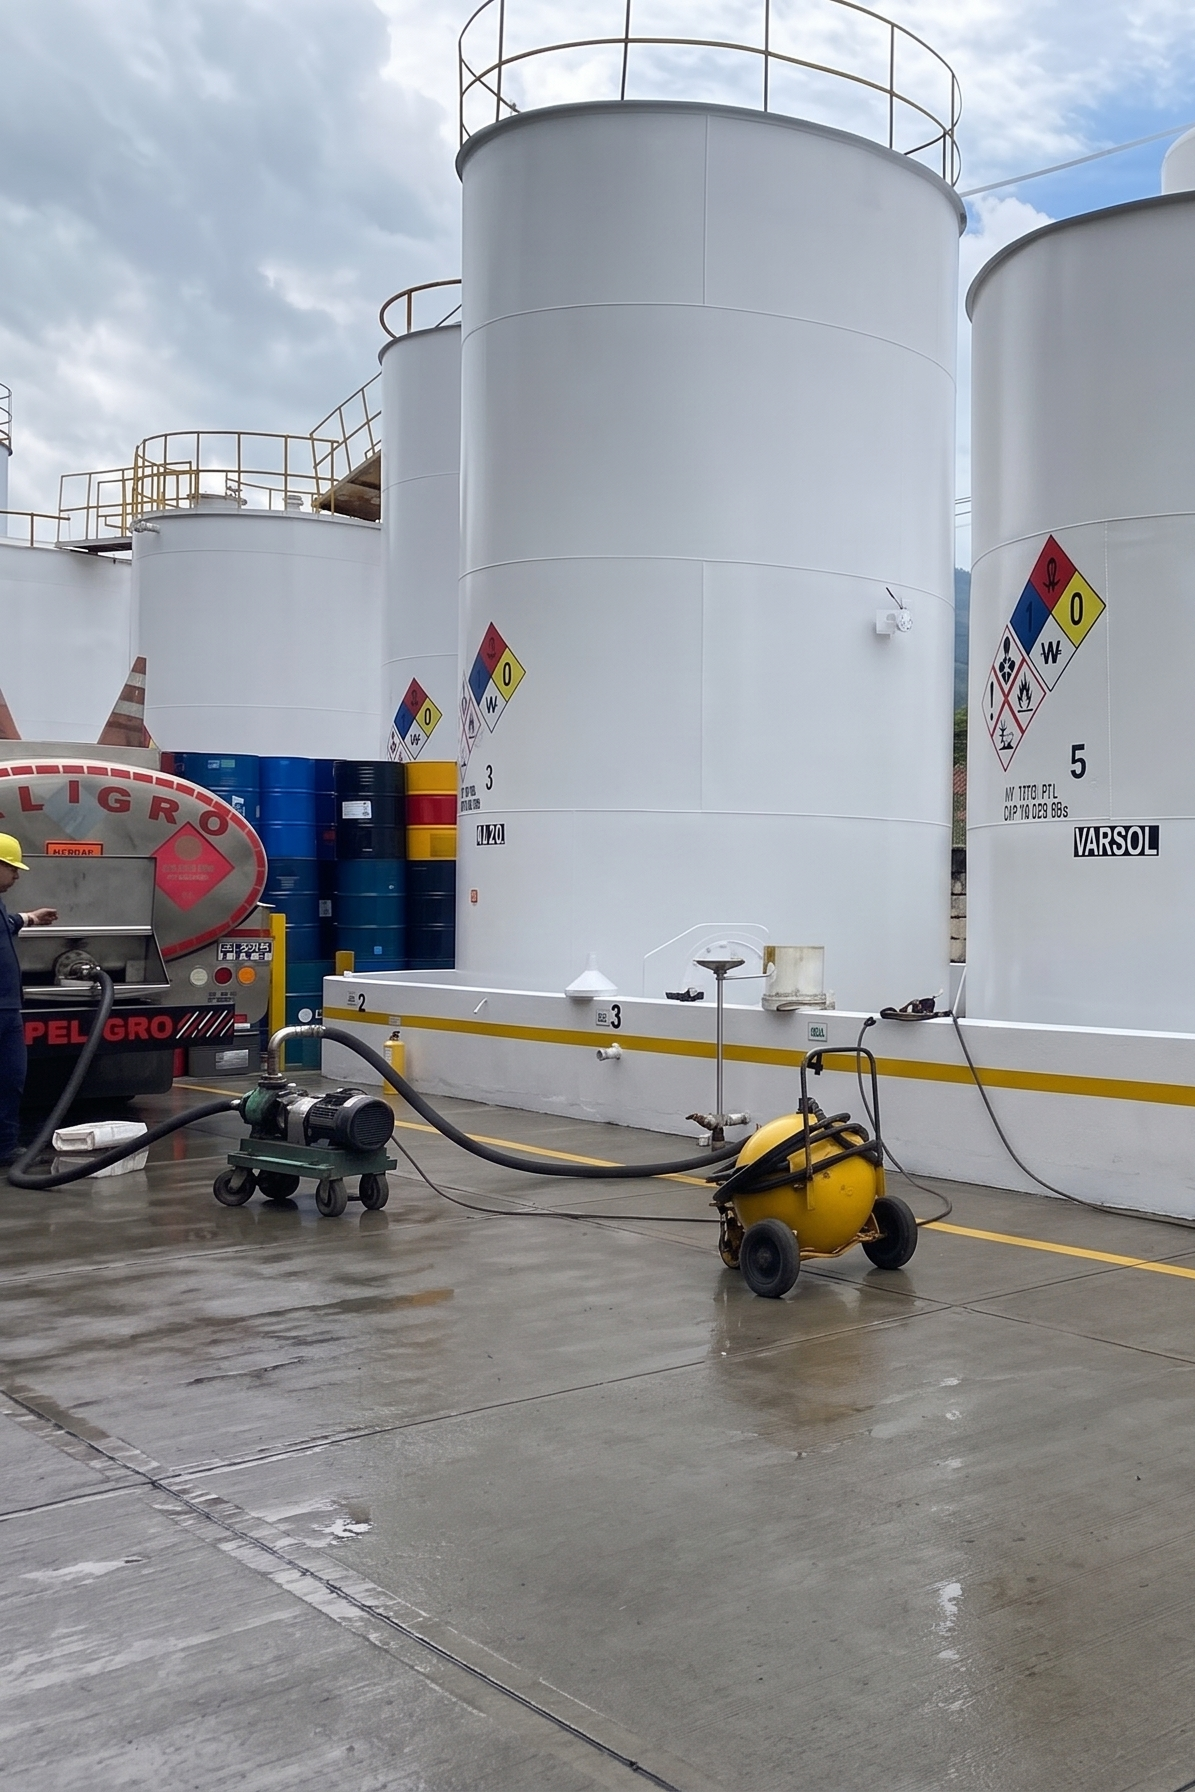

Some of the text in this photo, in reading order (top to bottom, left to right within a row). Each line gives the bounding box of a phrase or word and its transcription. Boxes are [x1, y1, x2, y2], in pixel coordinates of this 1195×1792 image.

[1070, 592, 1084, 626] 0
[502, 661, 512, 687] 0
[1070, 743, 1087, 779] 5
[485, 764, 493, 790] 3
[0, 780, 230, 837] LIGRO
[1075, 826, 1158, 856] VARSOL
[358, 993, 366, 1012] 2
[610, 1003, 621, 1029] 3
[806, 1049, 824, 1076] 4
